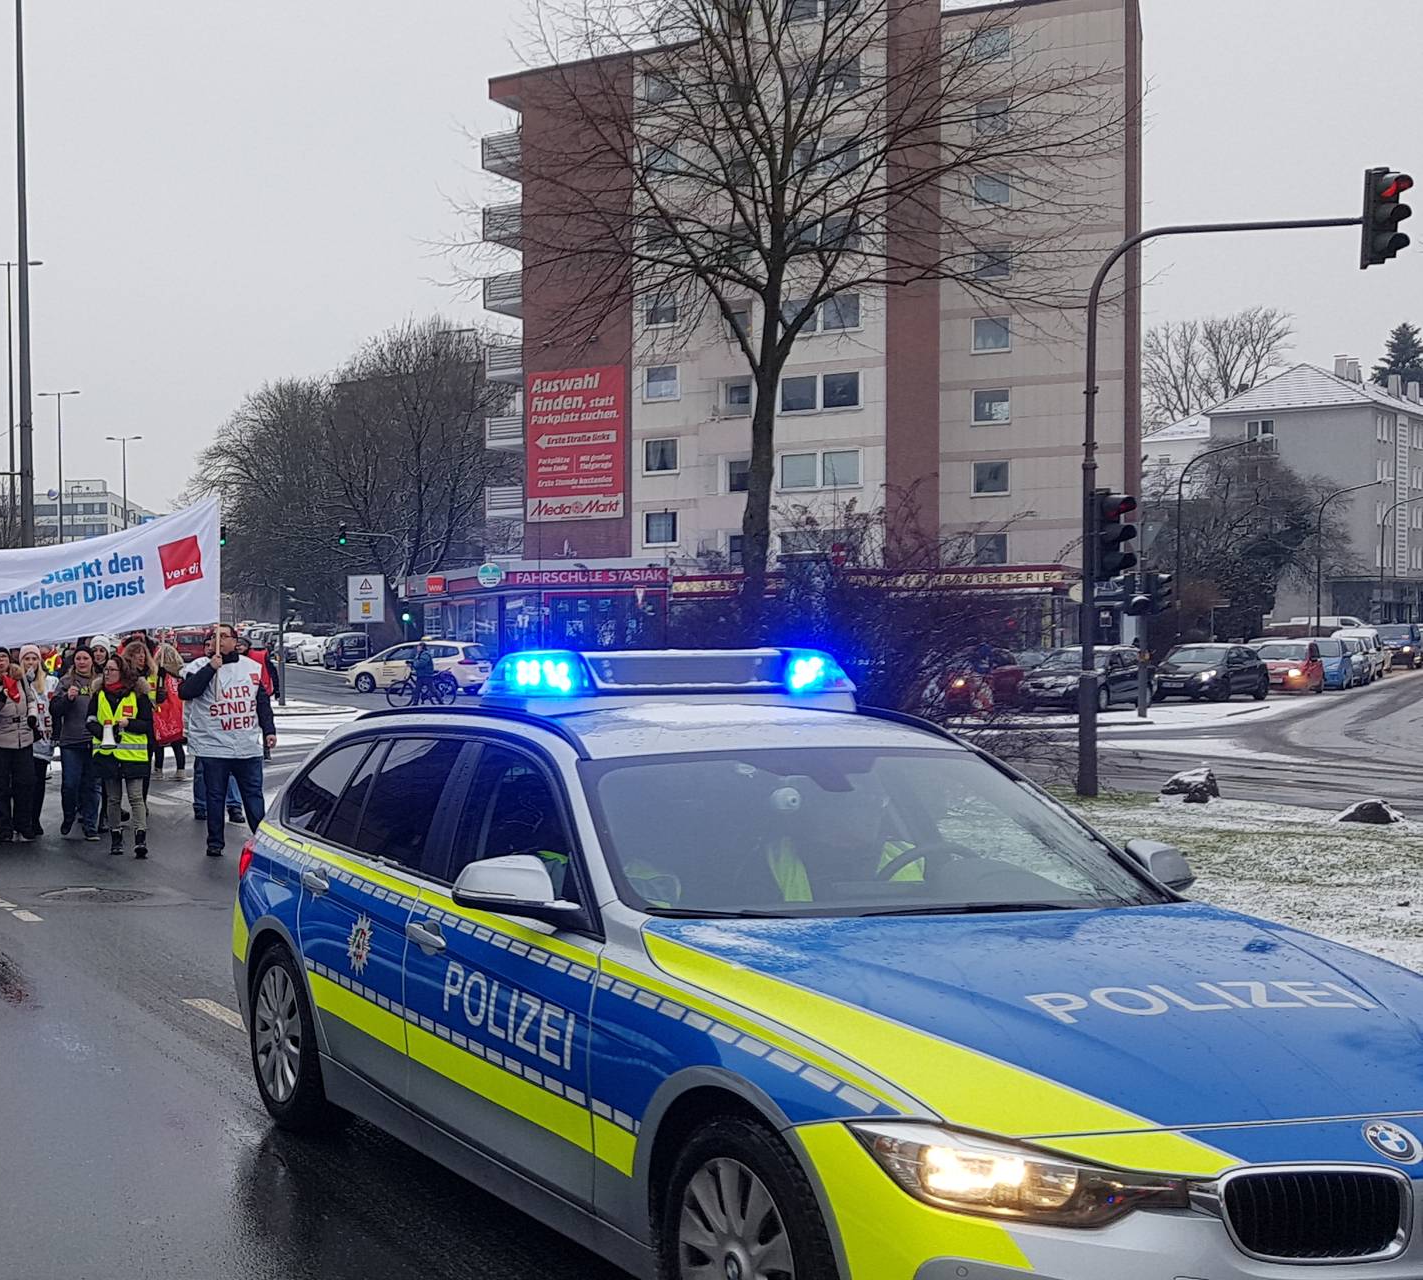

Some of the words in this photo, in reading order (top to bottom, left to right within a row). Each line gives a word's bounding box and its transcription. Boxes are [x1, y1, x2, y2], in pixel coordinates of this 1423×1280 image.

[531, 372, 600, 394] Auswahl
[531, 394, 586, 412] finden,
[589, 396, 614, 408] statt
[531, 412, 578, 426] Parkplatz
[580, 409, 619, 421] suchen.
[547, 436, 566, 445] Erste
[566, 433, 590, 445] Straße
[592, 432, 610, 442] links
[108, 551, 144, 575] den
[515, 570, 602, 584] FAHRSCHULE
[608, 570, 665, 582] STASIAK
[83, 575, 145, 604] Dienst
[222, 685, 251, 699] WIR
[209, 701, 247, 717] SIND
[1023, 981, 1379, 1024] POLIZEI
[443, 960, 576, 1071] POLIZEI
